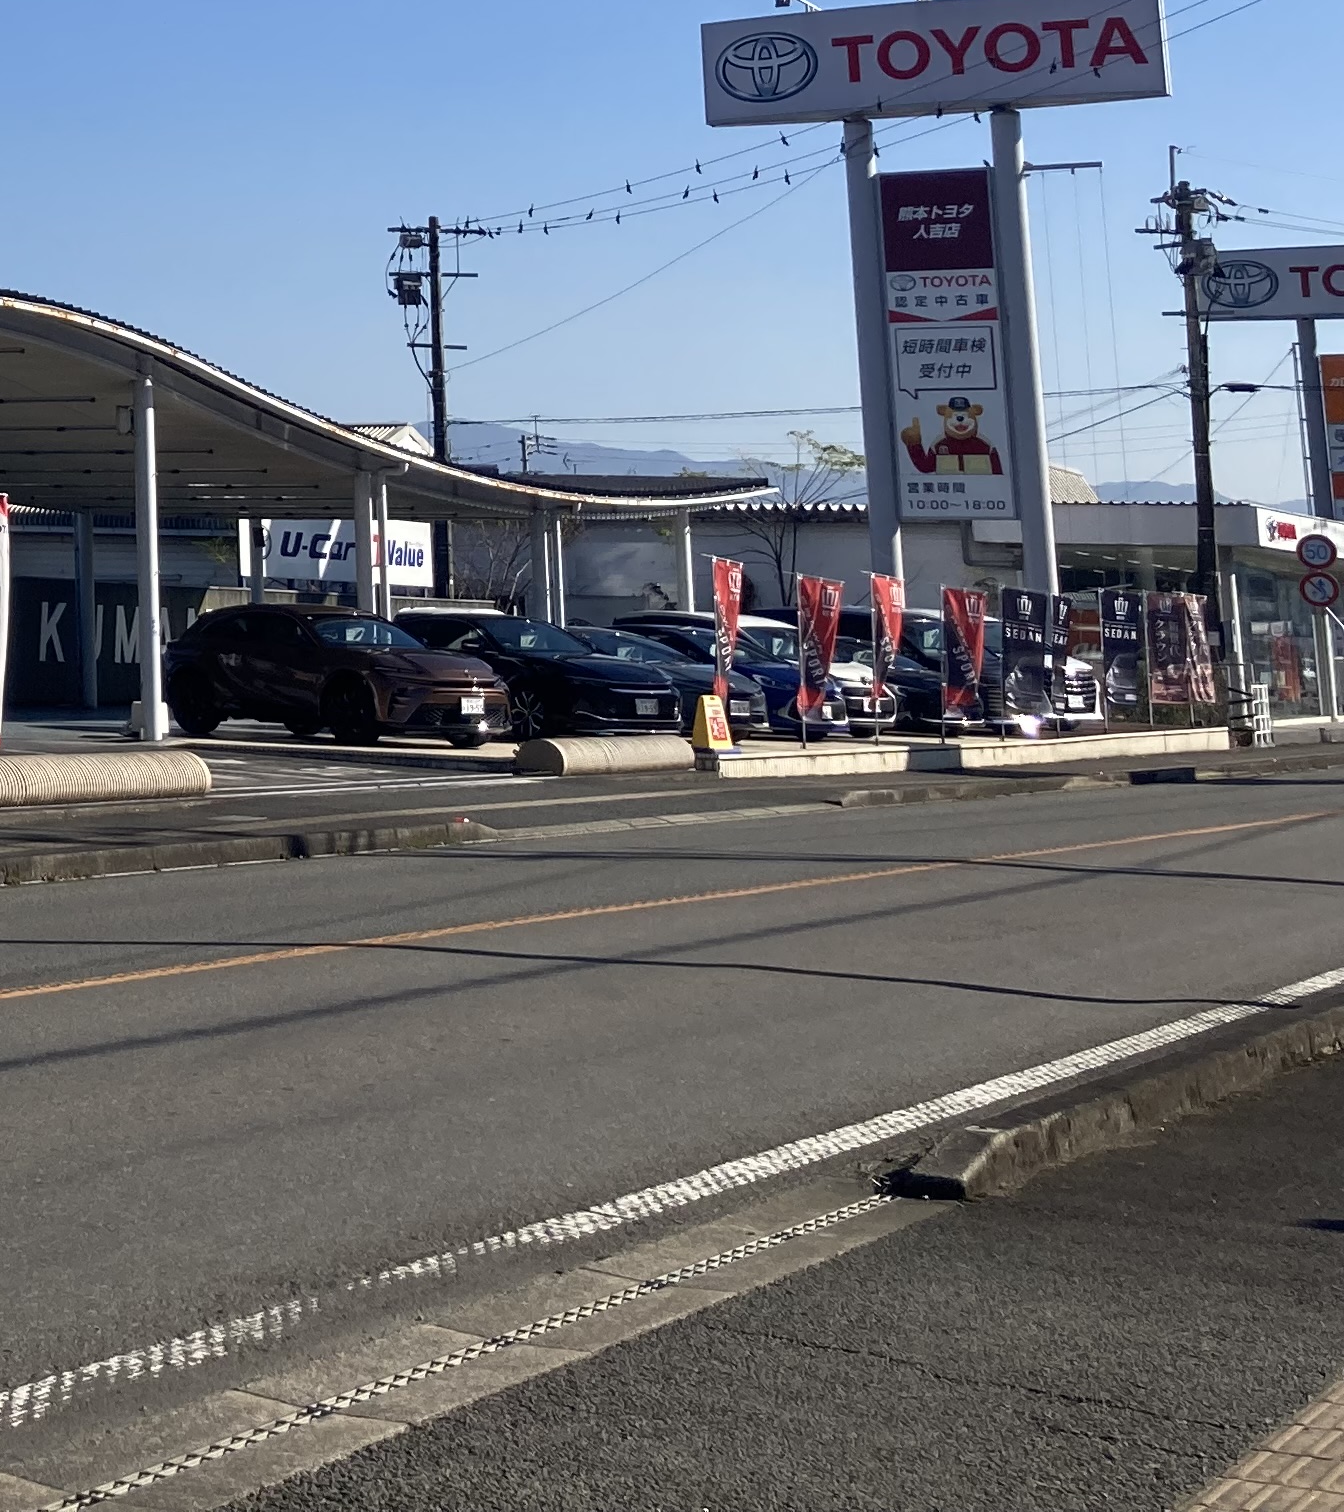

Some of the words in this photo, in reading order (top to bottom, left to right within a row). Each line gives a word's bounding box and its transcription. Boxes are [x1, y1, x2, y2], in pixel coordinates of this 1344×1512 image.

[832, 16, 1149, 83] TOYOTA
[897, 204, 974, 222] 熊本トヨタ
[912, 223, 962, 240] 人吉店
[919, 274, 993, 289] TOYOTA
[894, 293, 990, 309] 認定中古車
[901, 336, 987, 355] 短時間車検
[918, 362, 972, 380] 受付中
[907, 482, 967, 494] 営業時間
[280, 531, 356, 561] U-Car
[1304, 544, 1328, 560] 50
[1104, 628, 1137, 640] SEDAN
